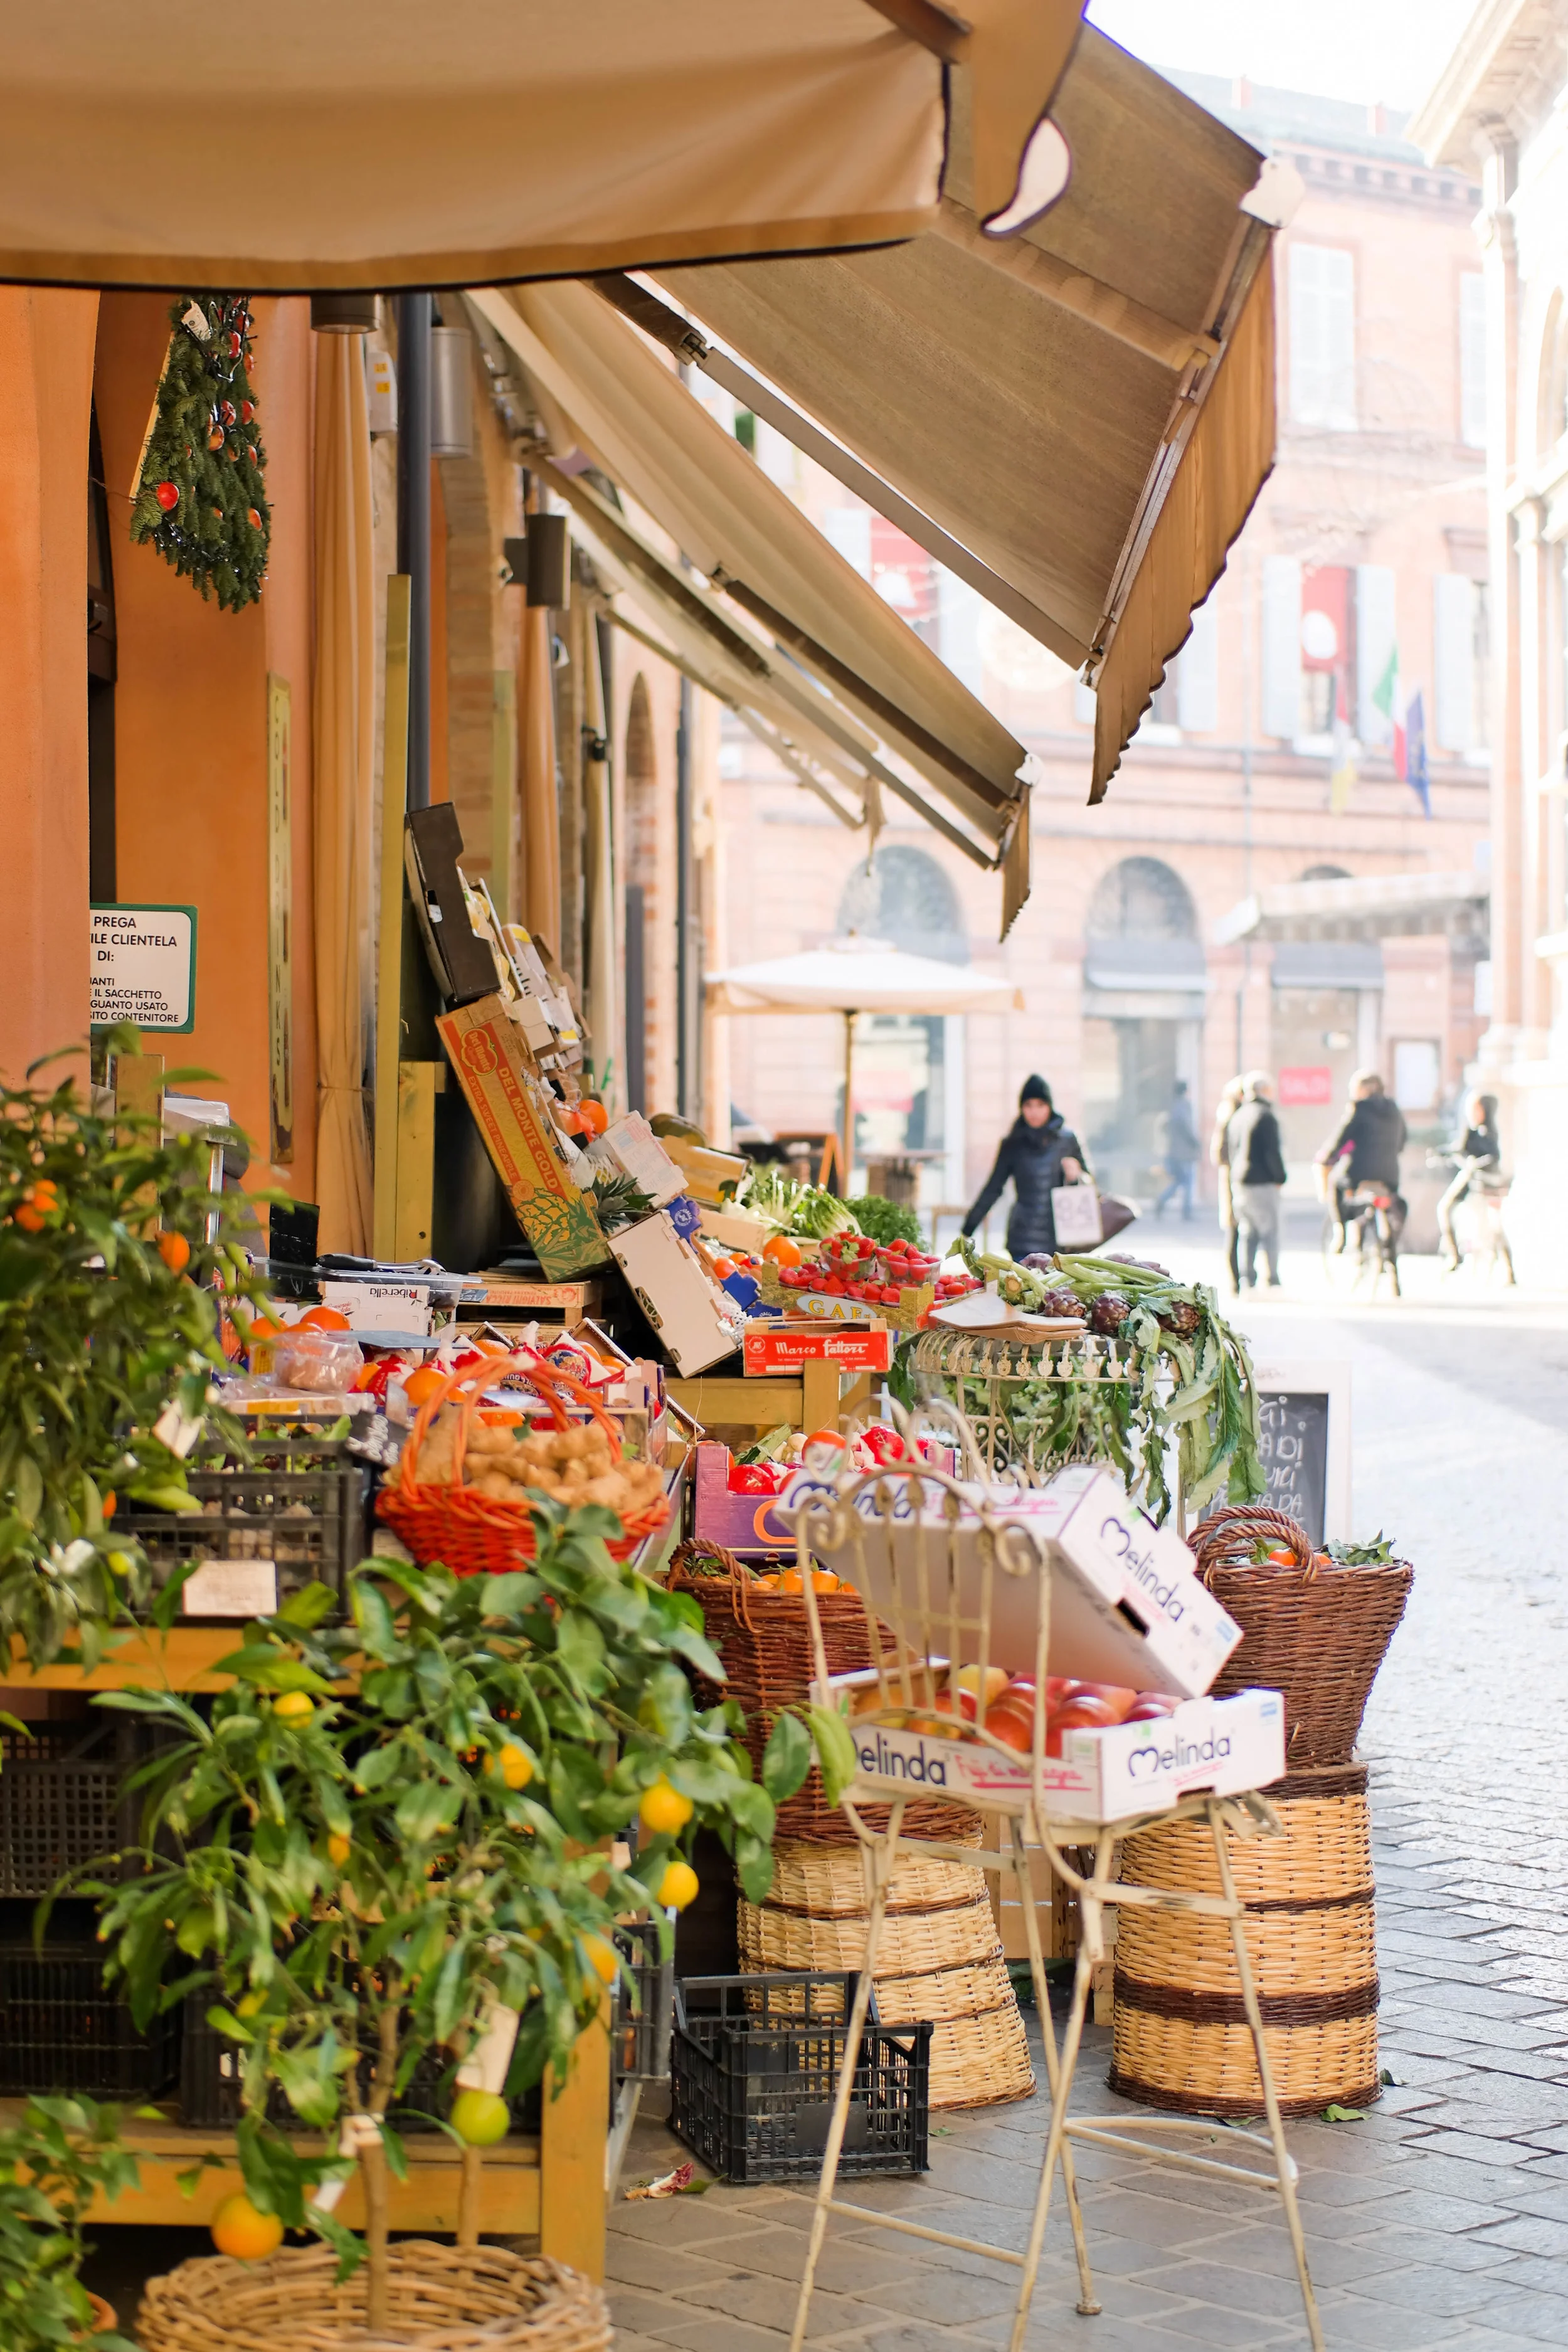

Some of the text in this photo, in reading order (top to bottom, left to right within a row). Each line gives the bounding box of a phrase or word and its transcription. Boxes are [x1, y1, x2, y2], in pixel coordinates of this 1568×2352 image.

[93, 916, 137, 928] PREGA
[90, 933, 177, 947] ILE CLIENTELA
[97, 950, 115, 961] DI:
[90, 977, 115, 986] ANTI
[94, 988, 102, 997] IL
[105, 988, 162, 999] SACCHETTO
[90, 1000, 168, 1011] GUANTO USATO
[111, 1012, 179, 1022] CONTENITORE
[469, 1076, 483, 1106] EXTRA
[479, 1104, 497, 1135] SWEET
[491, 1133, 519, 1178] PINEAPPLE
[499, 1066, 516, 1096] DEL
[512, 1097, 541, 1147] MONTE
[535, 1150, 559, 1189] GOLD
[369, 1287, 418, 1299] Riberella
[775, 1342, 817, 1354] Marco
[1100, 1517, 1184, 1623] Melinda
[1128, 1726, 1231, 1777] Melinda
[852, 1732, 946, 1786] elinda
